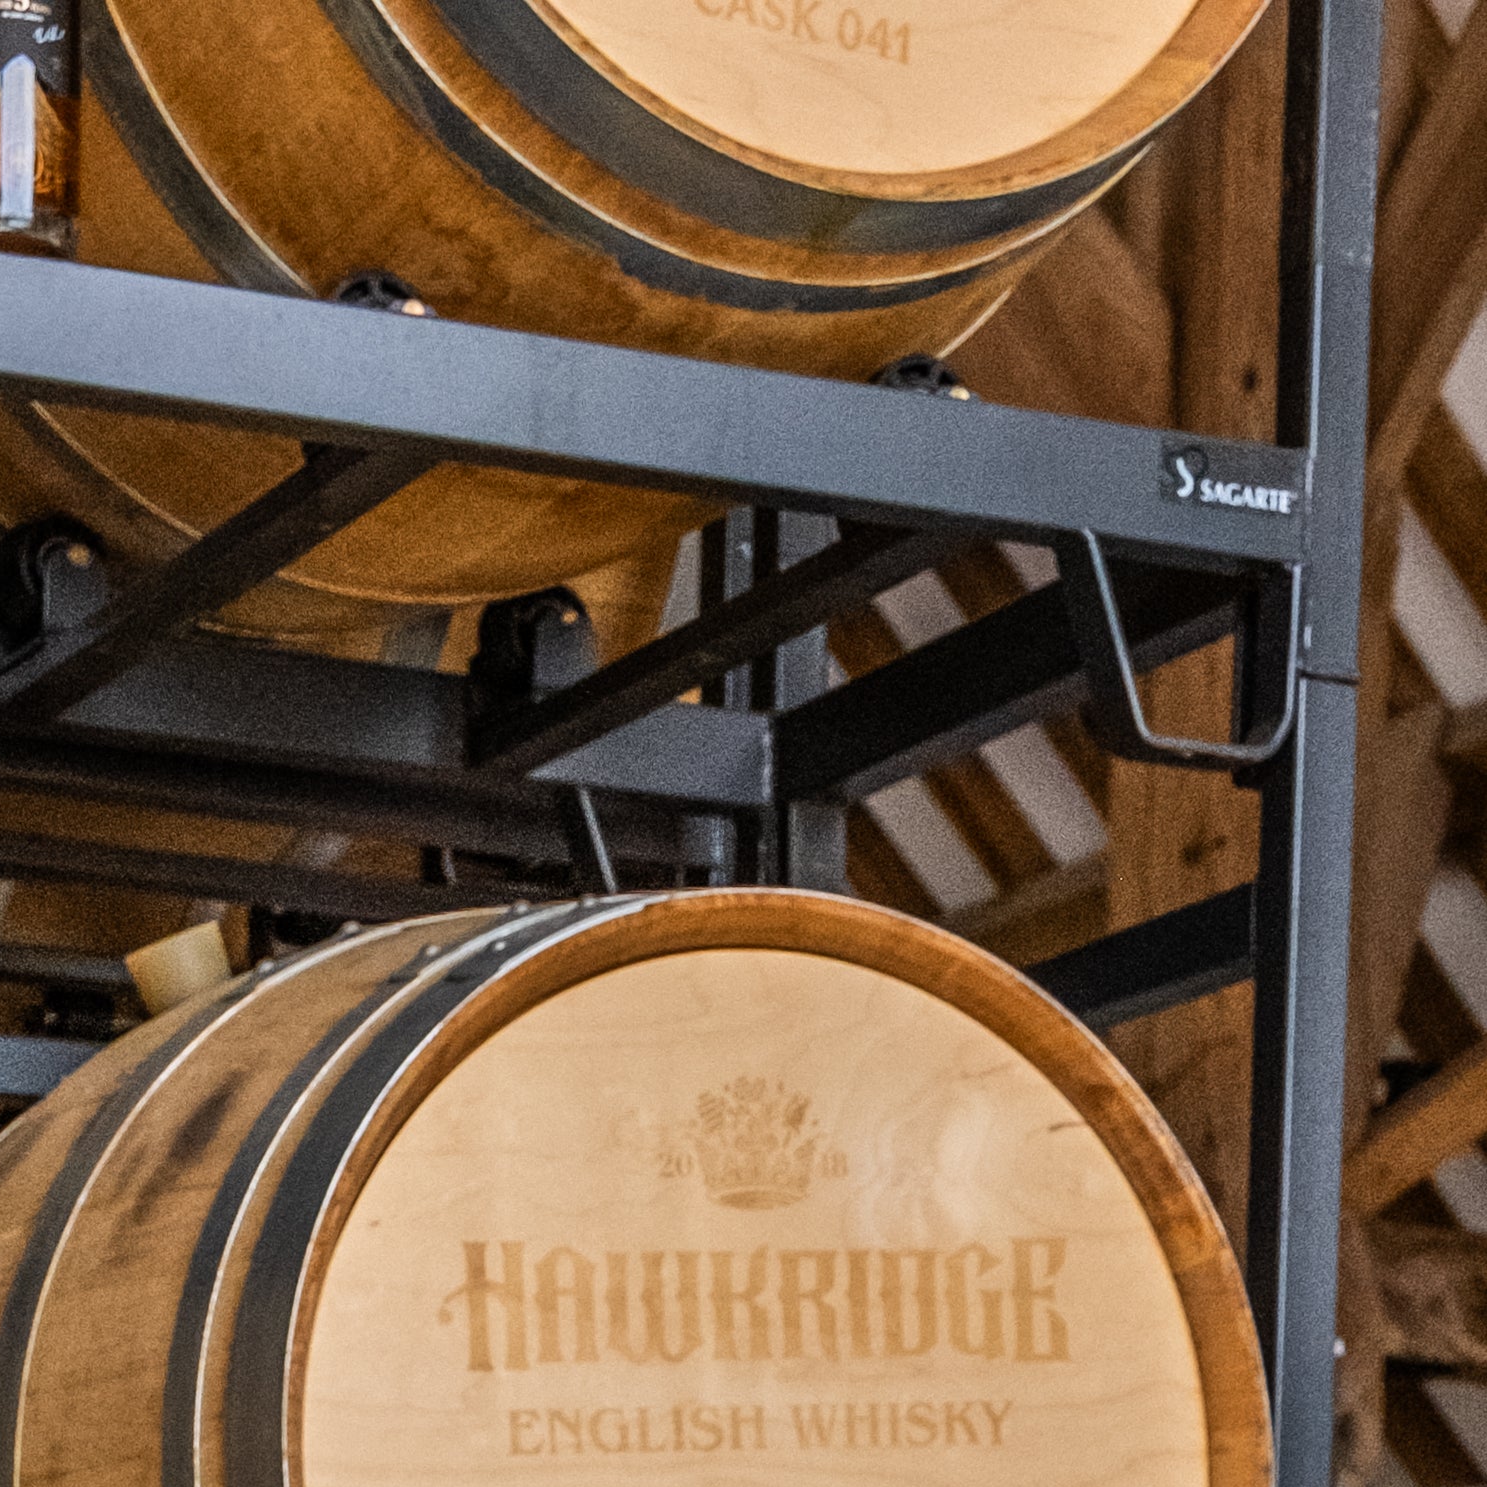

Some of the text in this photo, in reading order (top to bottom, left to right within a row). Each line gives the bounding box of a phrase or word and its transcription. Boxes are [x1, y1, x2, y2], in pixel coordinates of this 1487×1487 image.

[837, 8, 910, 65] 041
[1200, 478, 1291, 514] SAGARTE
[437, 1237, 1070, 1373] HAWKRIDGE
[506, 1400, 1015, 1457] ENGLISH WHISKY
